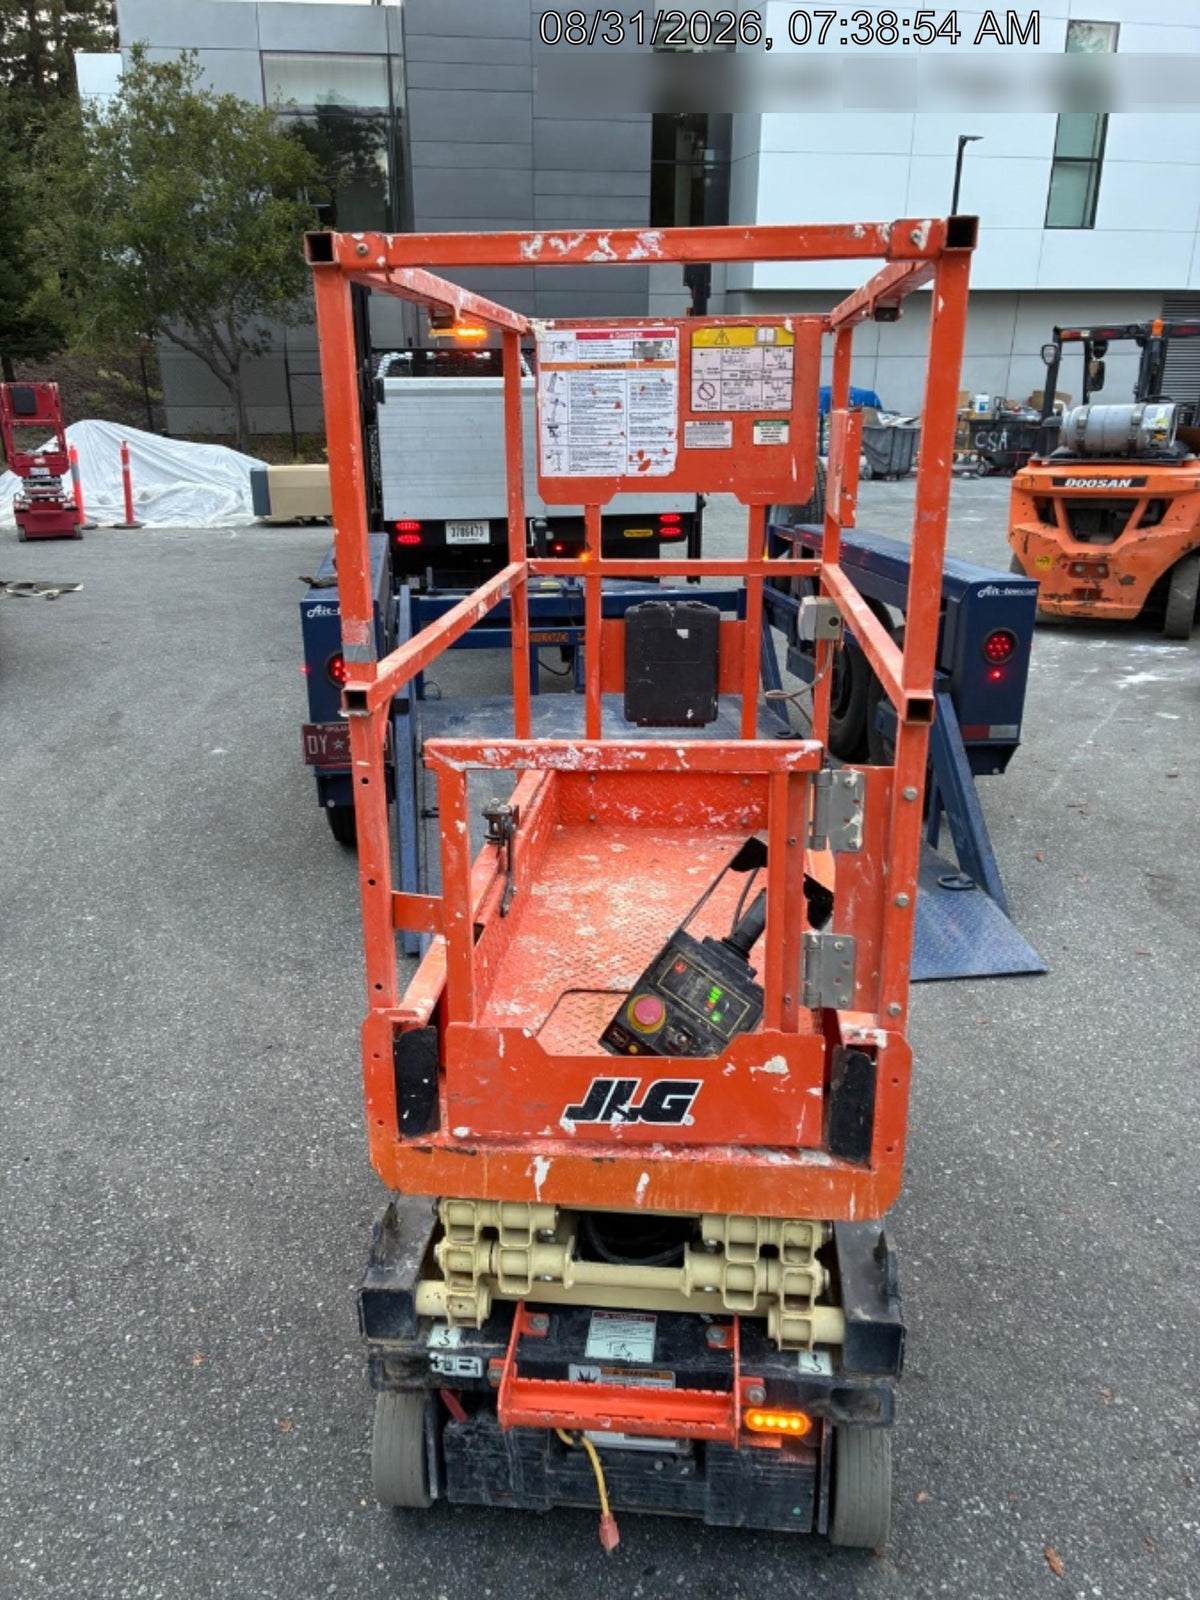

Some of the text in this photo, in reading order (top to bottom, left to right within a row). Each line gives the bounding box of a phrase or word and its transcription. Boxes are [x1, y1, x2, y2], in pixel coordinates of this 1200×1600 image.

[975, 427, 1008, 452] CSA
[1064, 478, 1132, 488] DOOSAN
[561, 1077, 704, 1126] JLG
